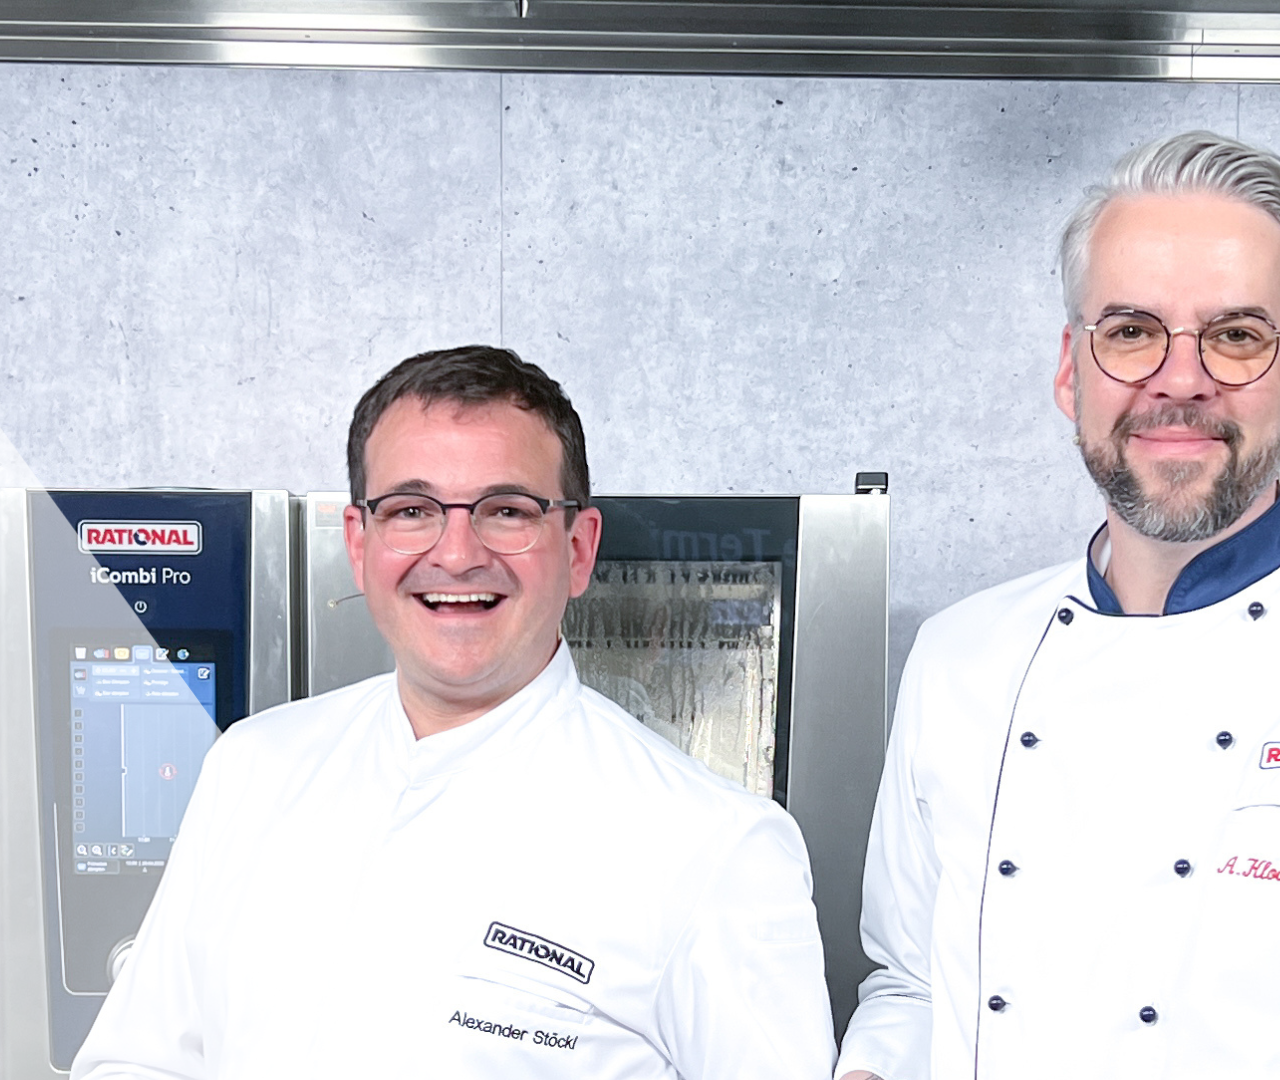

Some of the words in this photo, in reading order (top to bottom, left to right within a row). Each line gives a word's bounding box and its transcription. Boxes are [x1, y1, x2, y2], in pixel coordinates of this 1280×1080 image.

[86, 528, 195, 546] RATIONAL
[90, 567, 157, 584] iCombi
[162, 567, 191, 585] Pro
[1217, 855, 1240, 875] A.
[490, 927, 587, 979] RATIONAL
[448, 1009, 529, 1042] Alexander
[532, 1029, 579, 1051] Stöckl
